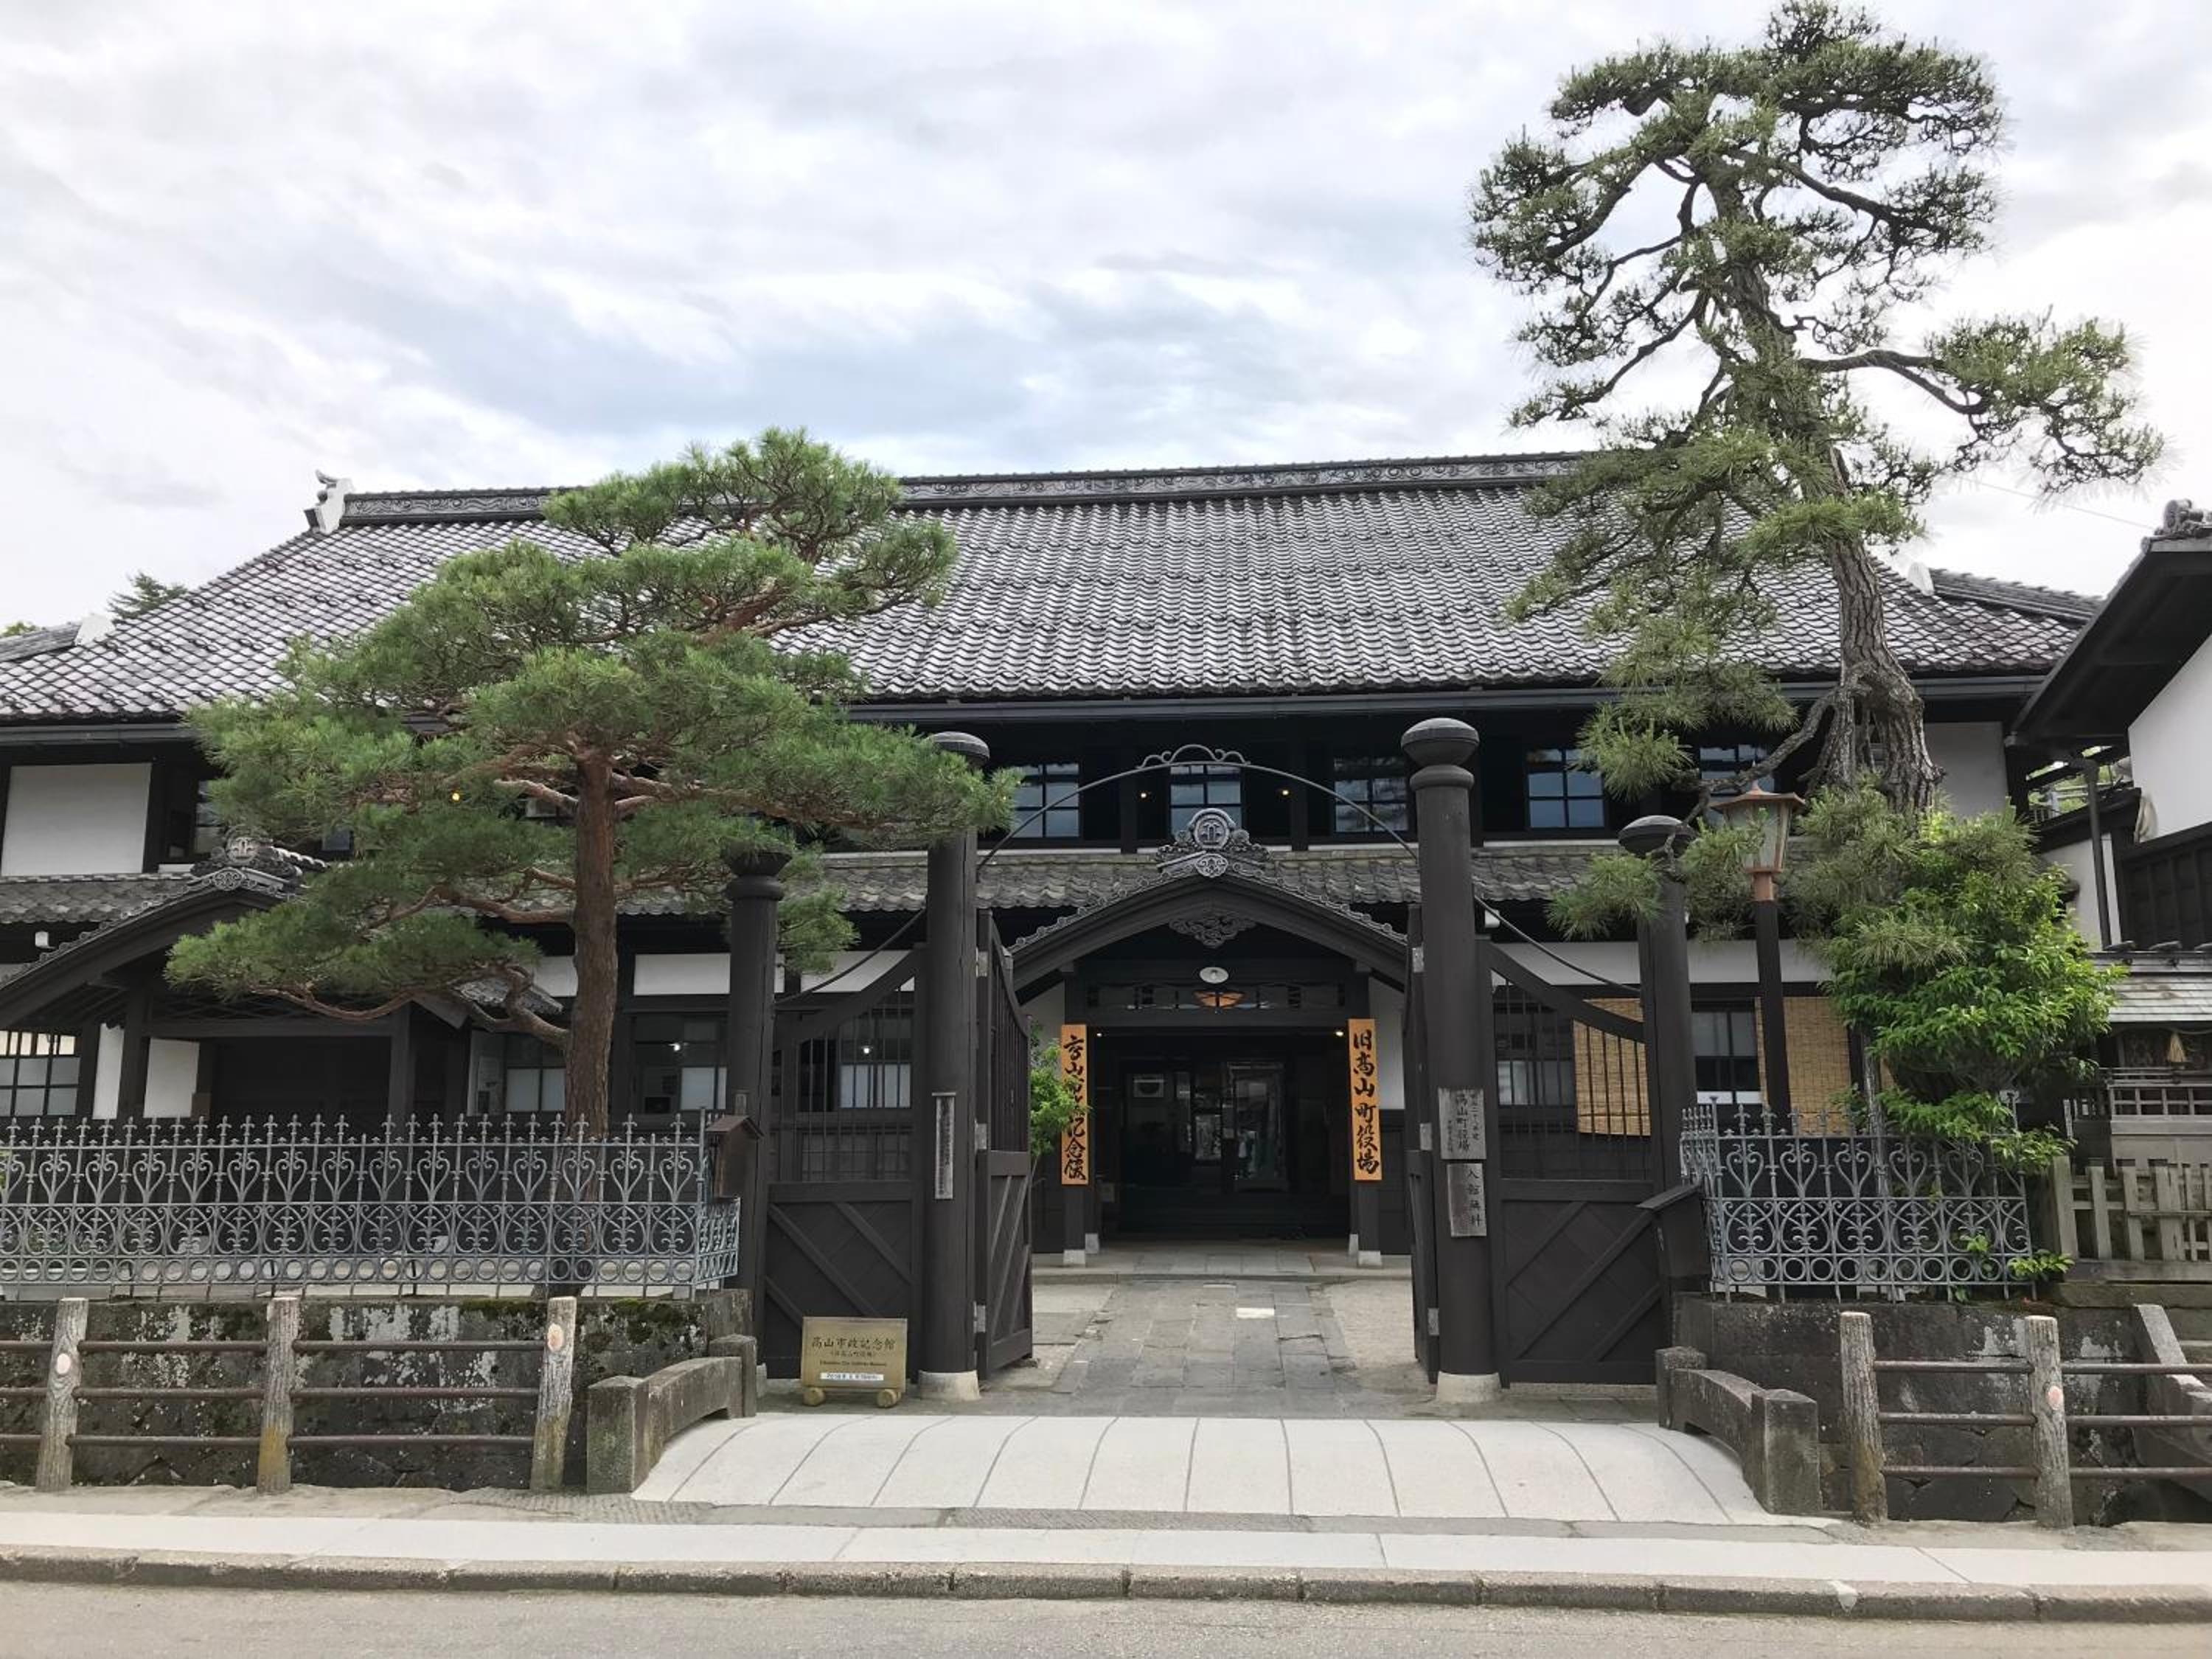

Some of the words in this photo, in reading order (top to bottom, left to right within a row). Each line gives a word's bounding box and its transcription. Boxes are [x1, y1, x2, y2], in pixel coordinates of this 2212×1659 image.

[1062, 1034, 1086, 1180] 高山記念館
[1353, 1029, 1379, 1174] 旧高山町役場
